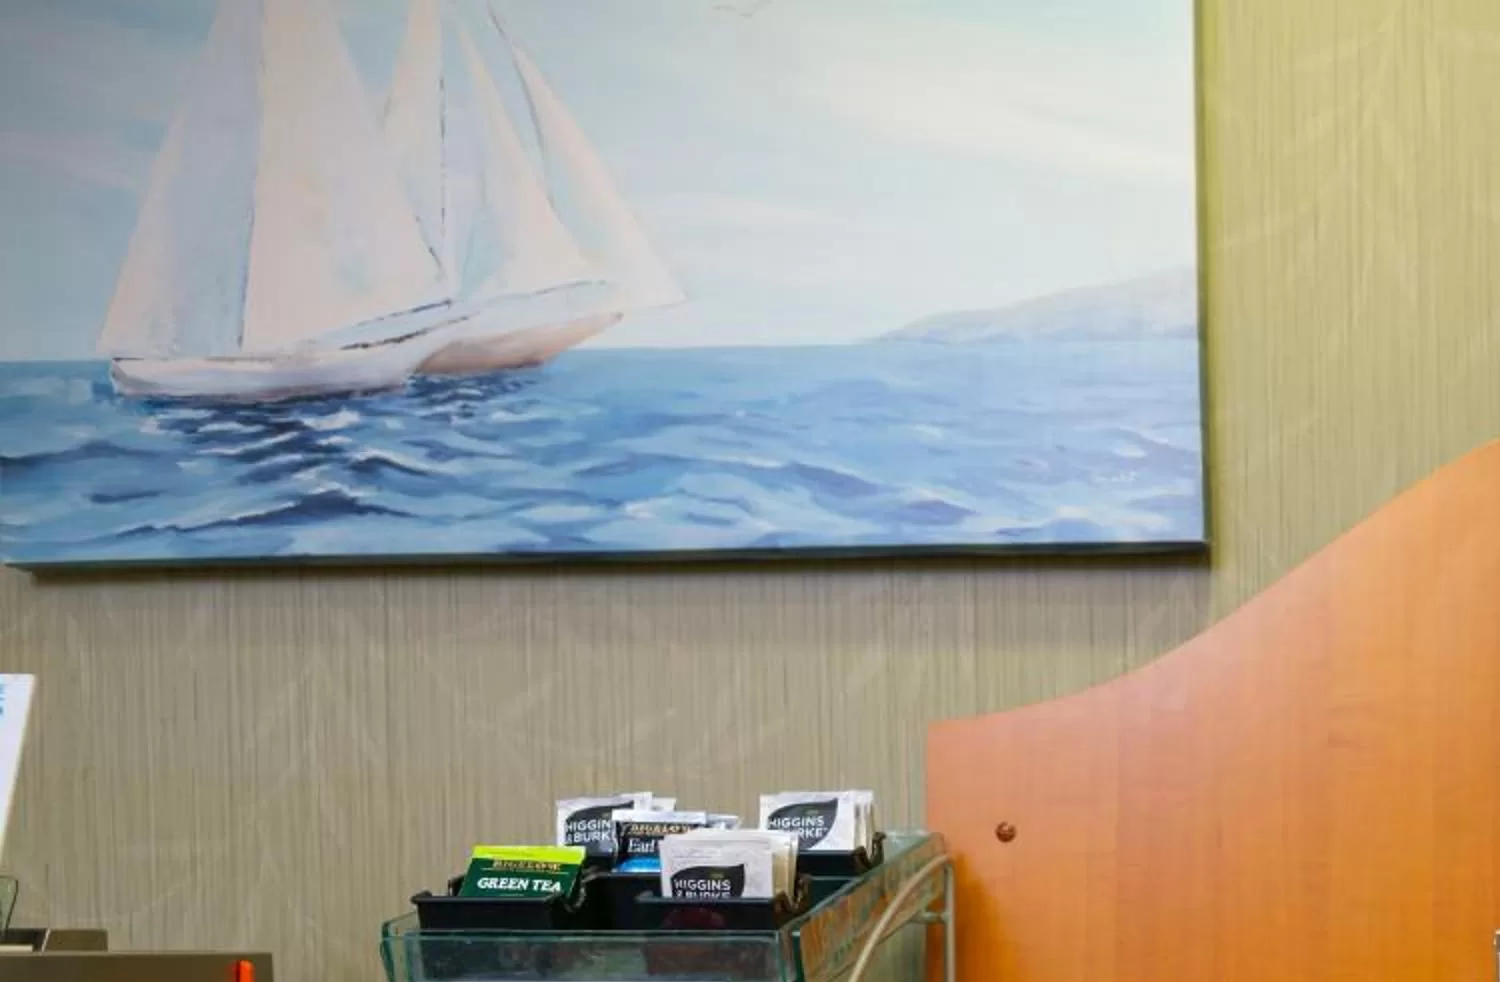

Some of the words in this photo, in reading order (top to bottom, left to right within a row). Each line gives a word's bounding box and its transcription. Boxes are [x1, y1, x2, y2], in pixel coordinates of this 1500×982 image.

[566, 819, 612, 831] HIGGIN
[573, 830, 611, 843] BURK
[477, 877, 530, 891] GREEN
[532, 879, 562, 892] TEA
[673, 879, 732, 891] HIGGINS
